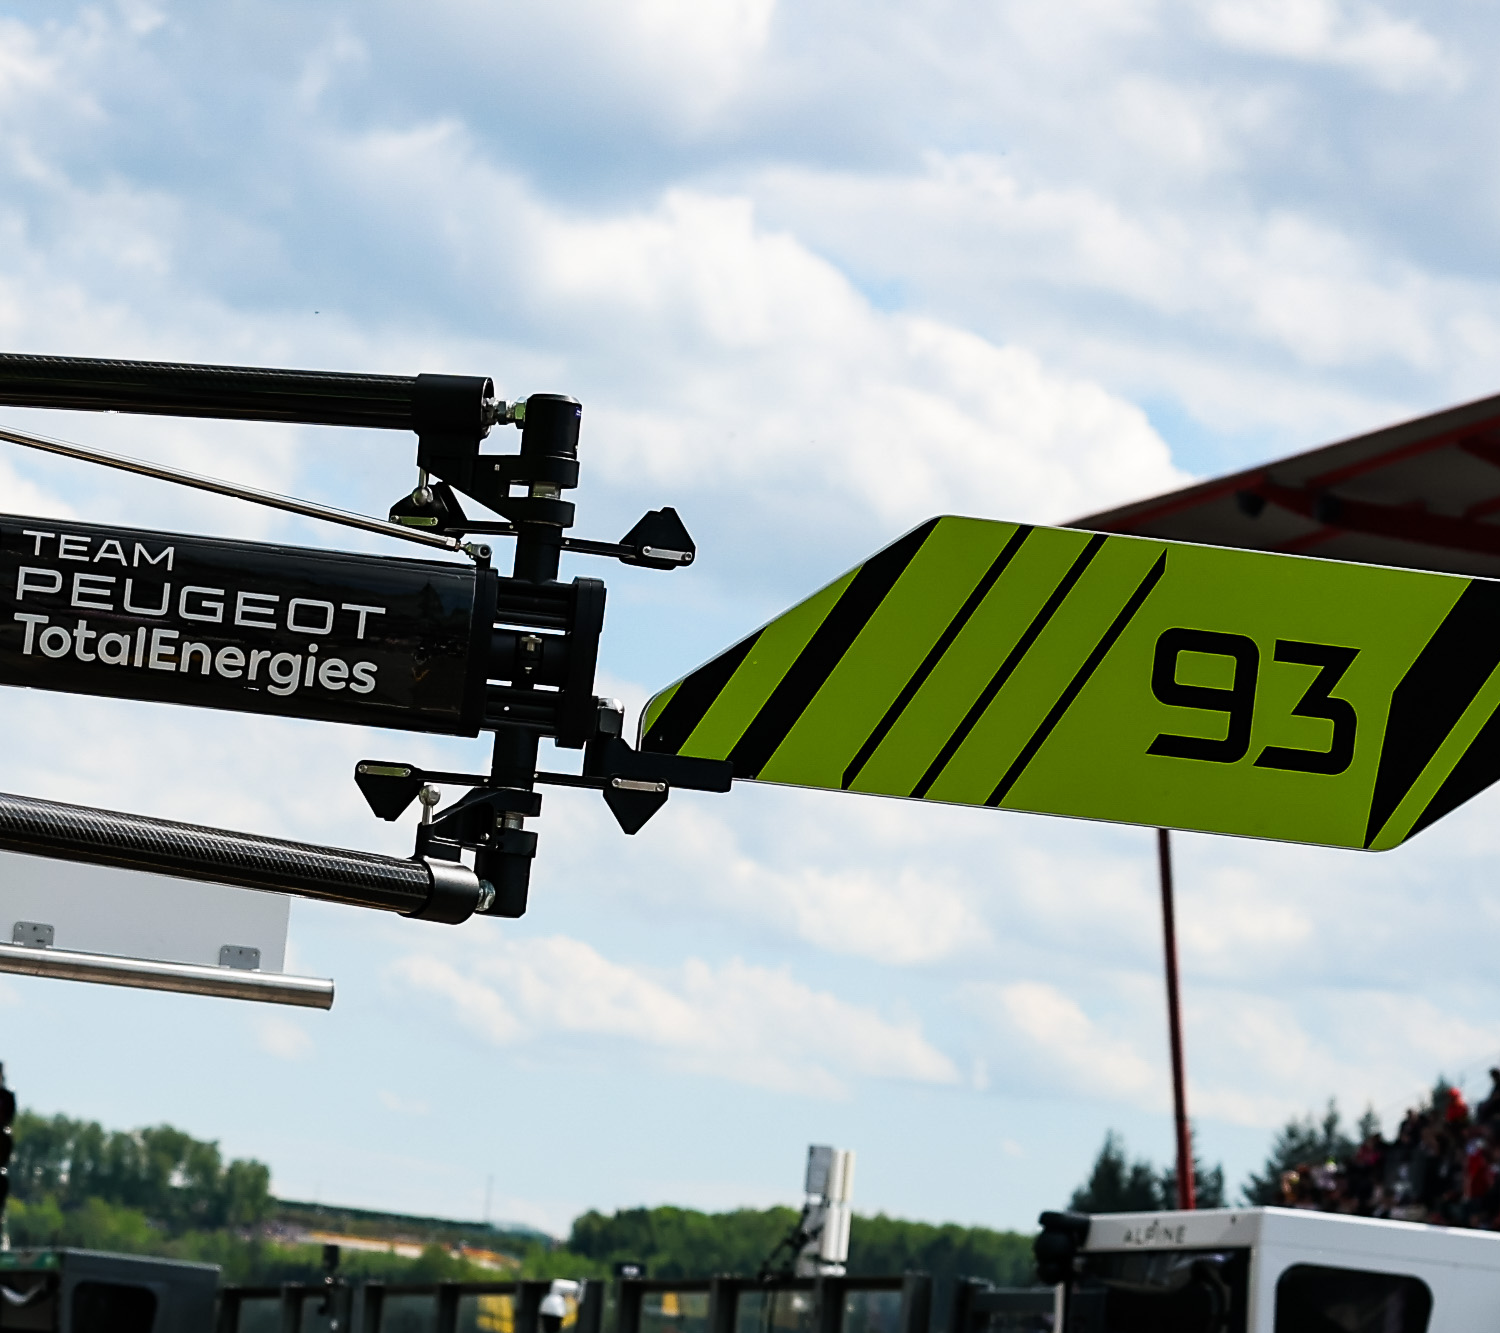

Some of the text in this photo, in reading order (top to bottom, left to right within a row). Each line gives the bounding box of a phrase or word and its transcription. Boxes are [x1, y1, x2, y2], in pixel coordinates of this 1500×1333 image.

[22, 529, 176, 572] TEAM
[15, 566, 387, 640] PEUGEOT
[13, 612, 379, 696] TotalEnergies
[1145, 626, 1362, 777] 93
